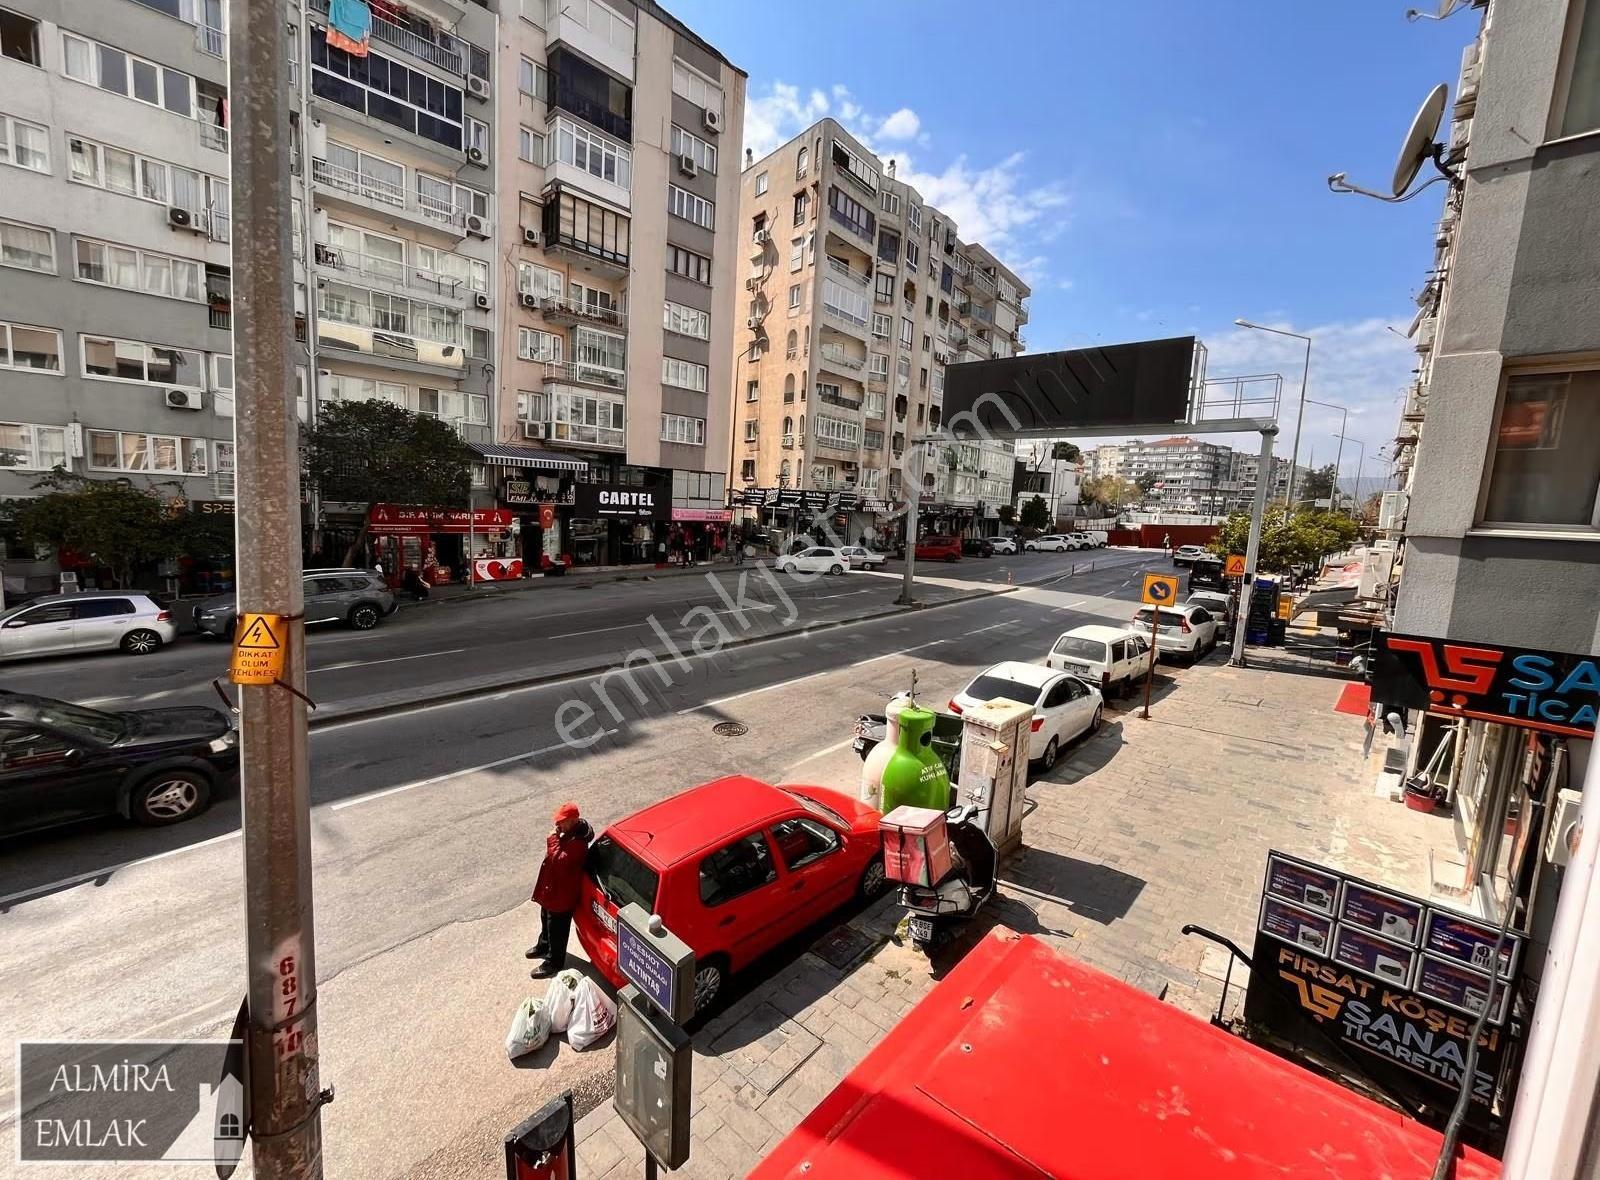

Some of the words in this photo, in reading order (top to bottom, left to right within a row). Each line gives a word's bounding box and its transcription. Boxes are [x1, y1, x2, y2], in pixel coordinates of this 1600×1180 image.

[599, 490, 654, 506] CARTEL
[636, 943, 660, 969] ESHOT
[1279, 948, 1375, 998] FIRSAT
[628, 959, 660, 997] ALTINTAŞ
[1345, 1000, 1494, 1081] SANAL
